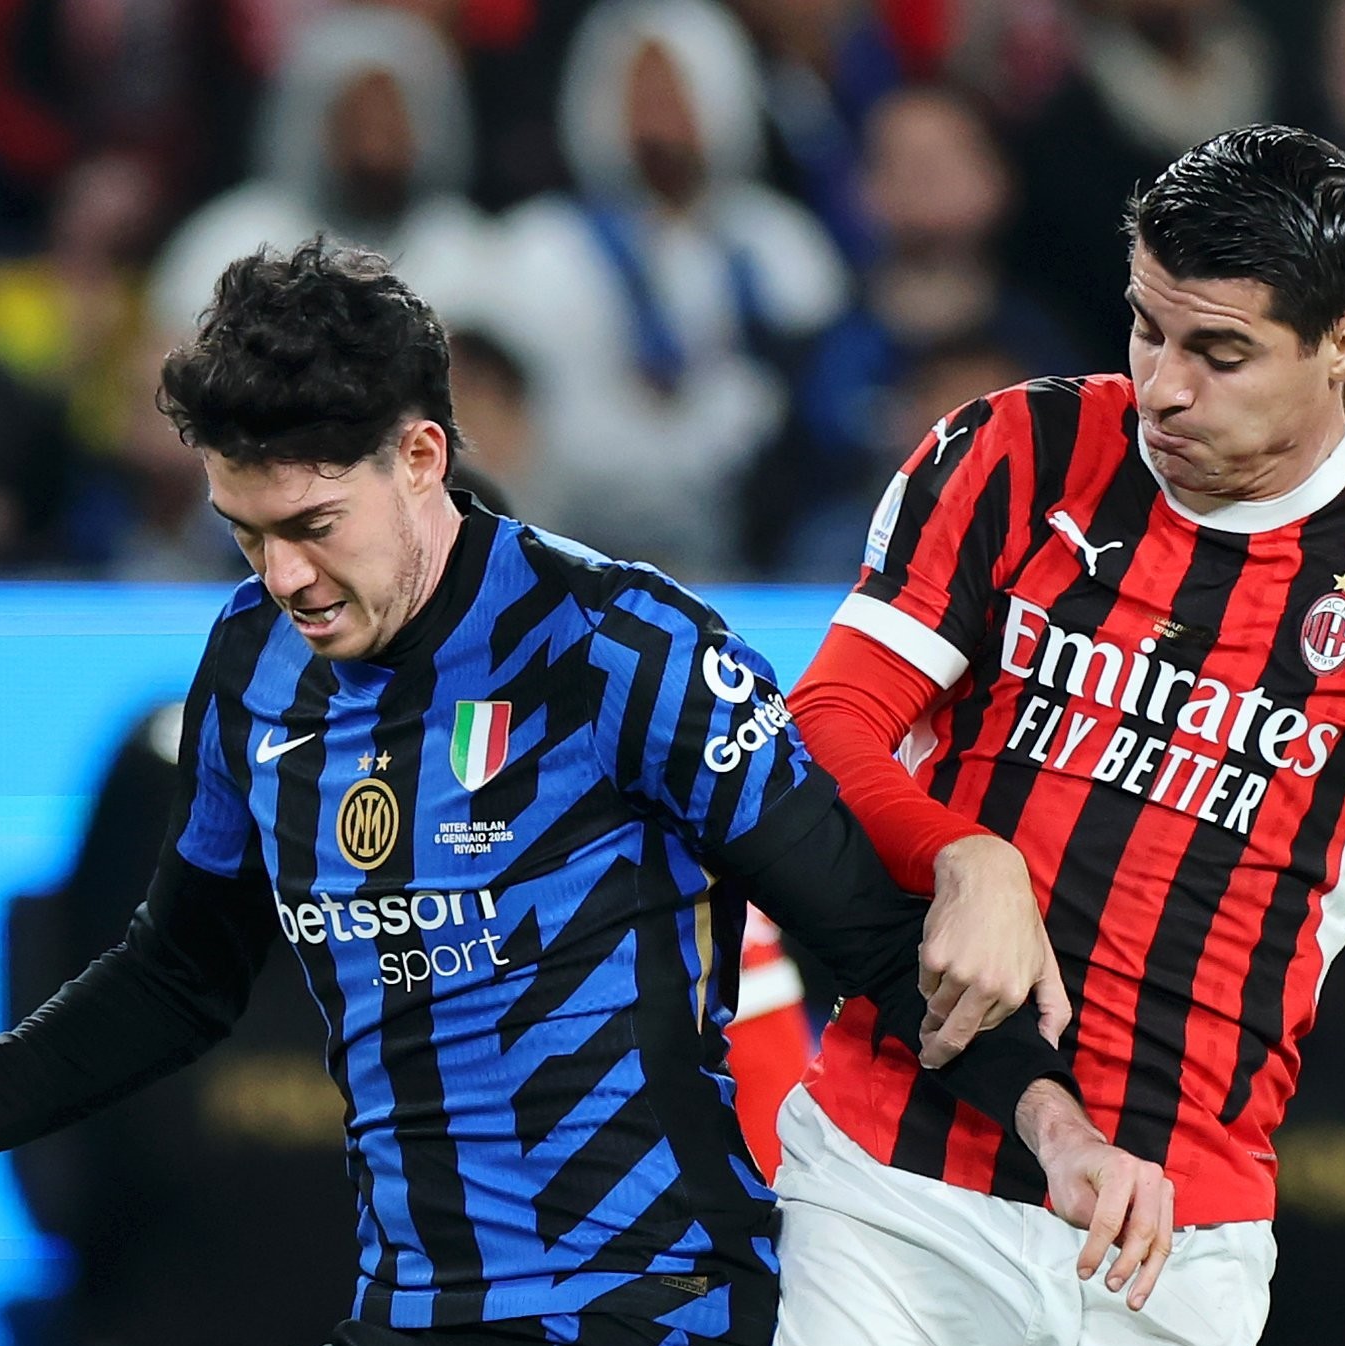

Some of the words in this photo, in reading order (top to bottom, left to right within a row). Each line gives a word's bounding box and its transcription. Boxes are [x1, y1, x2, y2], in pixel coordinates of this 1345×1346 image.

[1309, 652, 1335, 667] 1899
[1001, 595, 1339, 777] Emirates
[1006, 695, 1098, 770] FLY
[1091, 725, 1269, 835] BETTER
[434, 833, 441, 844] 6
[442, 833, 486, 843] GENNAIO
[488, 832, 513, 842] 2025
[454, 844, 491, 854] RIYADH
[274, 889, 497, 944] betsson
